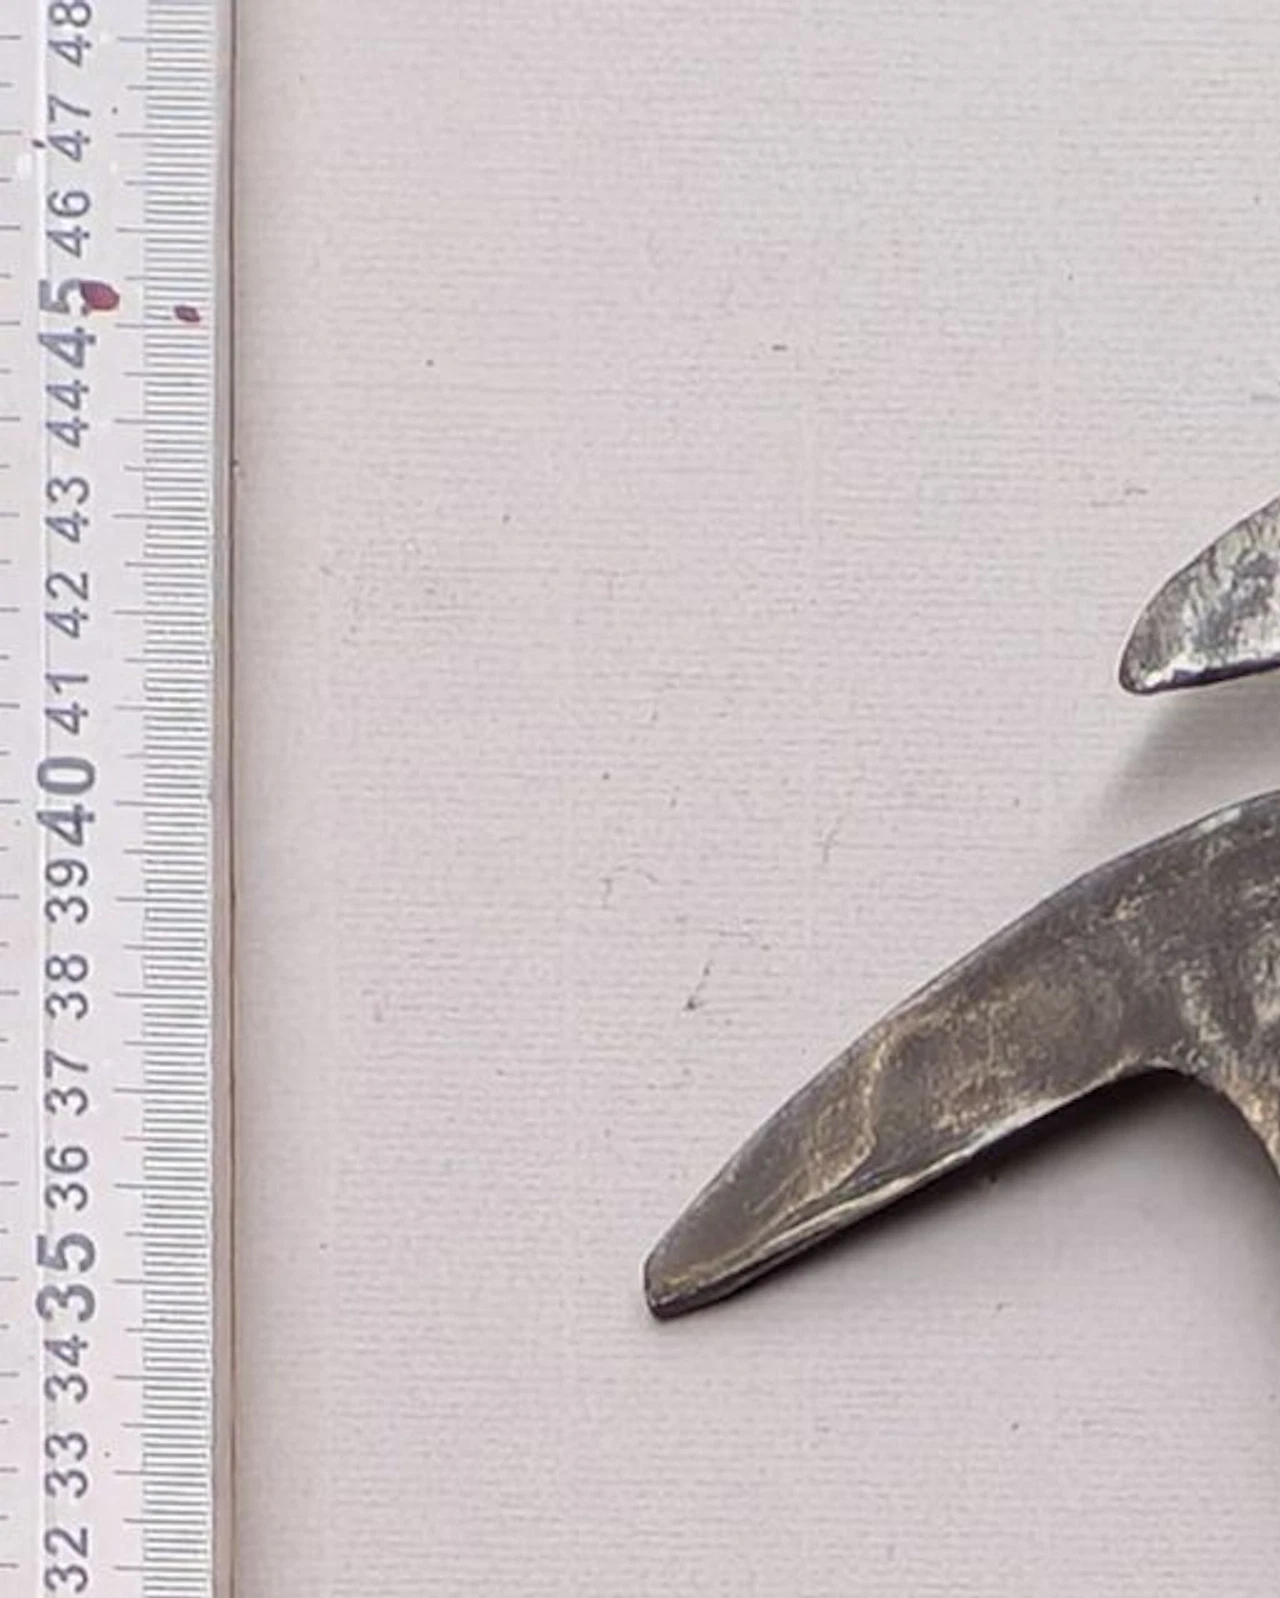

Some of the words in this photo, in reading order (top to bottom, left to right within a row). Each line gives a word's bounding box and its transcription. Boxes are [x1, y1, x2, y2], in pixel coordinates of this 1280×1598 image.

[47, 0, 93, 68] 48
[46, 93, 92, 163] 47
[45, 190, 92, 259] 46
[37, 277, 97, 370] 45
[44, 379, 90, 449] 44
[44, 476, 90, 544] 43
[44, 572, 89, 640] 42
[43, 672, 90, 736] 41
[35, 756, 96, 848] 40
[43, 858, 89, 925] 39
[43, 954, 89, 1021] 38
[43, 1048, 89, 1117] 37
[43, 1145, 89, 1212] 36
[34, 1233, 96, 1323] 35
[42, 1334, 89, 1404] 34
[43, 1432, 89, 1499] 33
[43, 1526, 89, 1594] 32
